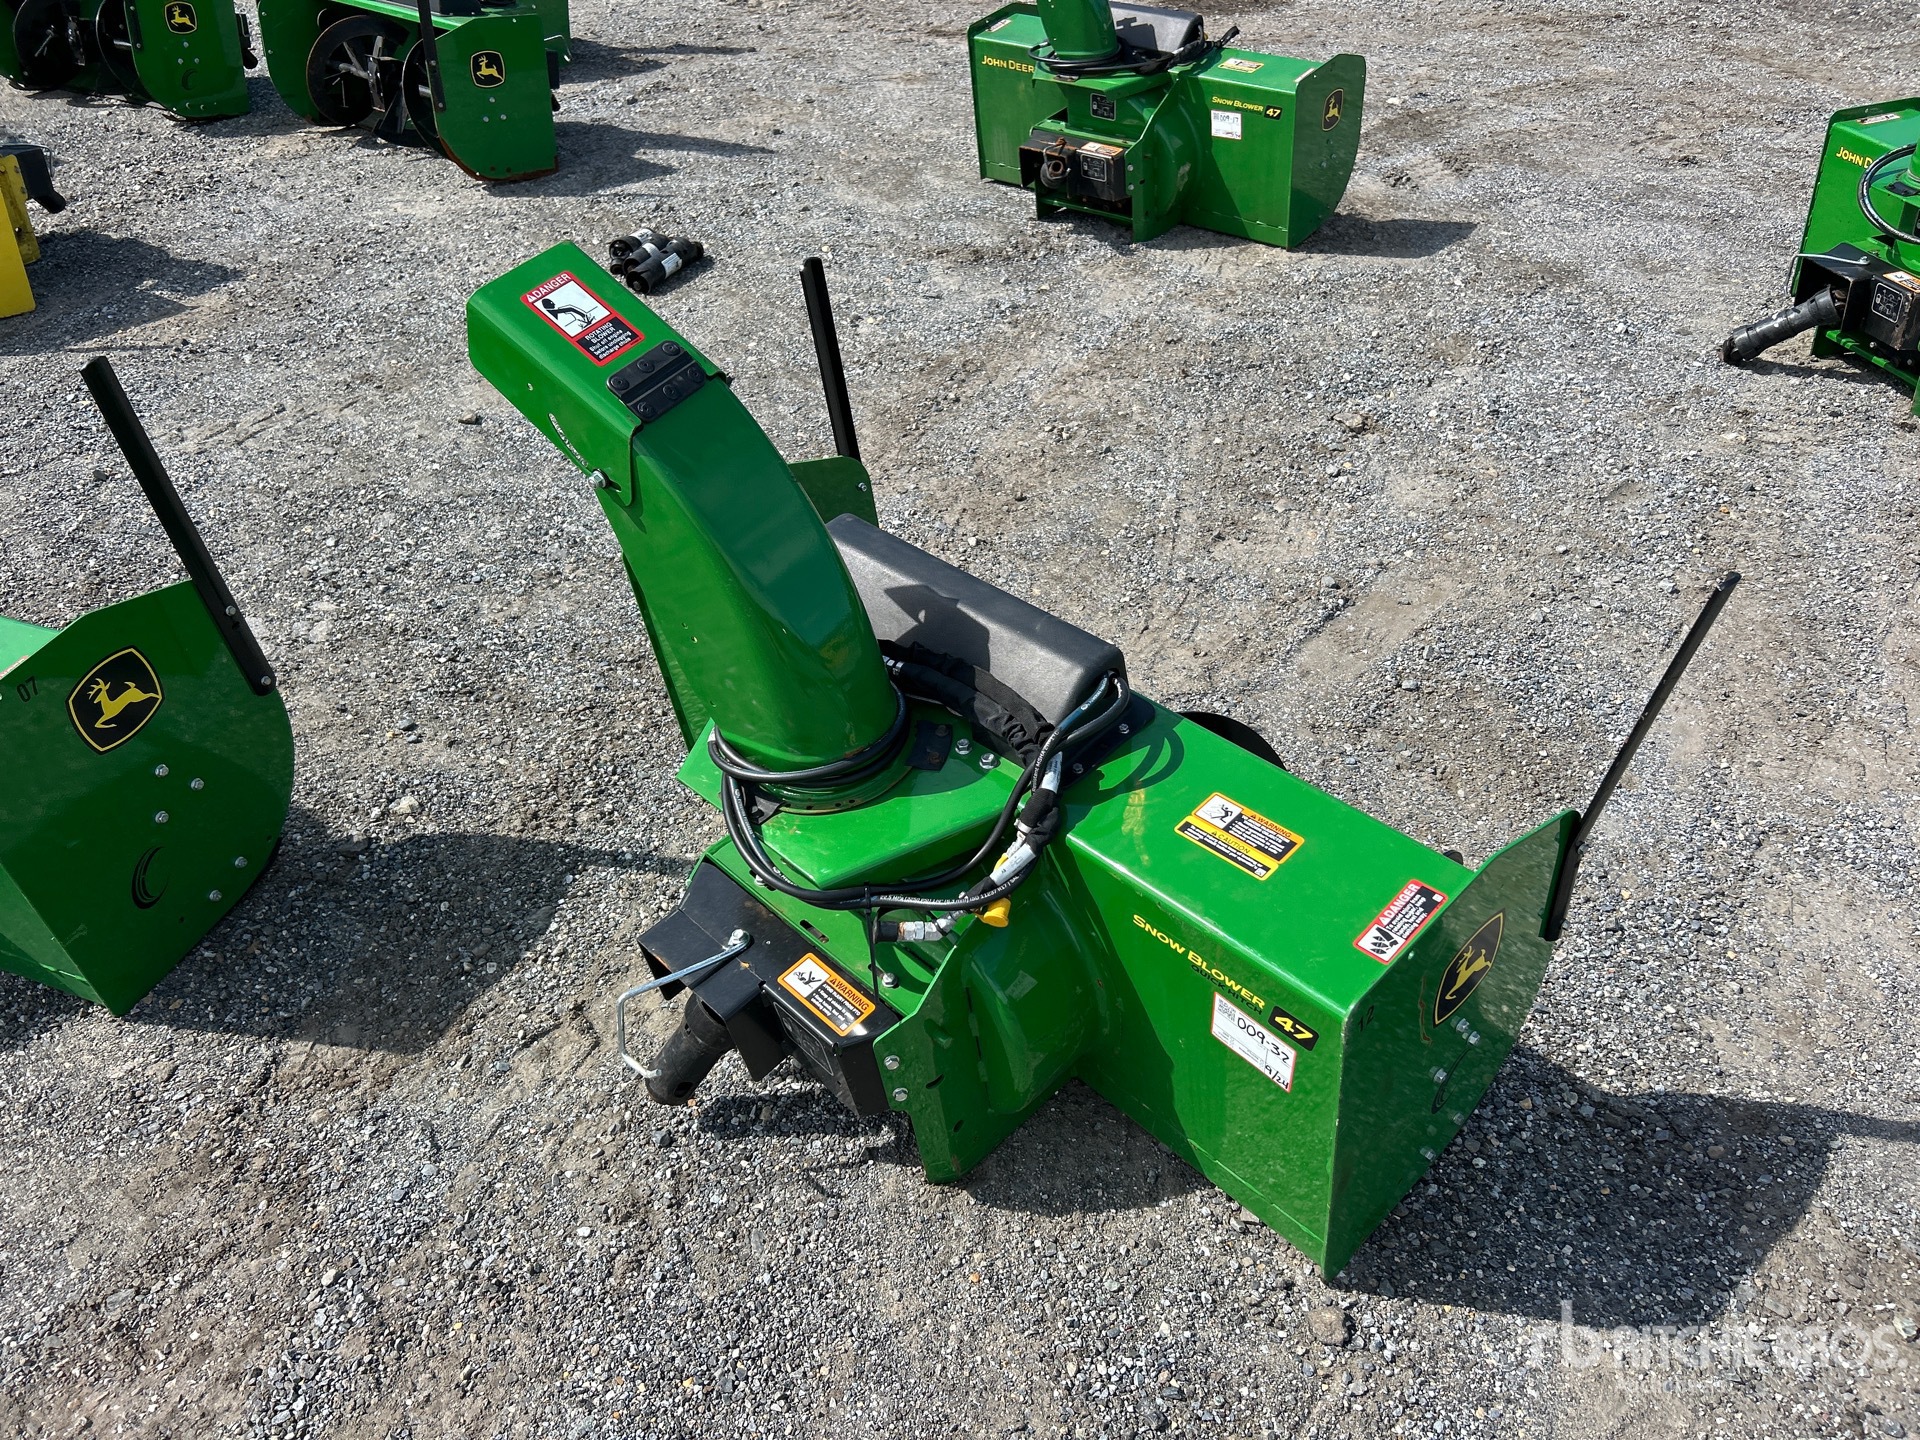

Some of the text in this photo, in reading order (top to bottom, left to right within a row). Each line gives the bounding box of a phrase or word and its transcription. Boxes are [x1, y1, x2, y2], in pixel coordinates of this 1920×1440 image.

[982, 56, 1034, 73] JOHN DEER
[1212, 96, 1233, 106] SNOW
[1234, 100, 1264, 112] BLOWER
[1266, 108, 1280, 117] 47
[1836, 147, 1863, 166] JOHN
[532, 272, 572, 299] DANGER
[16, 676, 38, 702] 07
[1258, 817, 1292, 838] WARNING
[1218, 833, 1250, 854] CAUTION
[1384, 883, 1420, 921] DANGER
[1132, 914, 1266, 1010] SNOW BLOWER
[835, 982, 870, 1012] WARNING
[1191, 964, 1262, 1015] QUICK HITCH
[1274, 1015, 1314, 1041] 47
